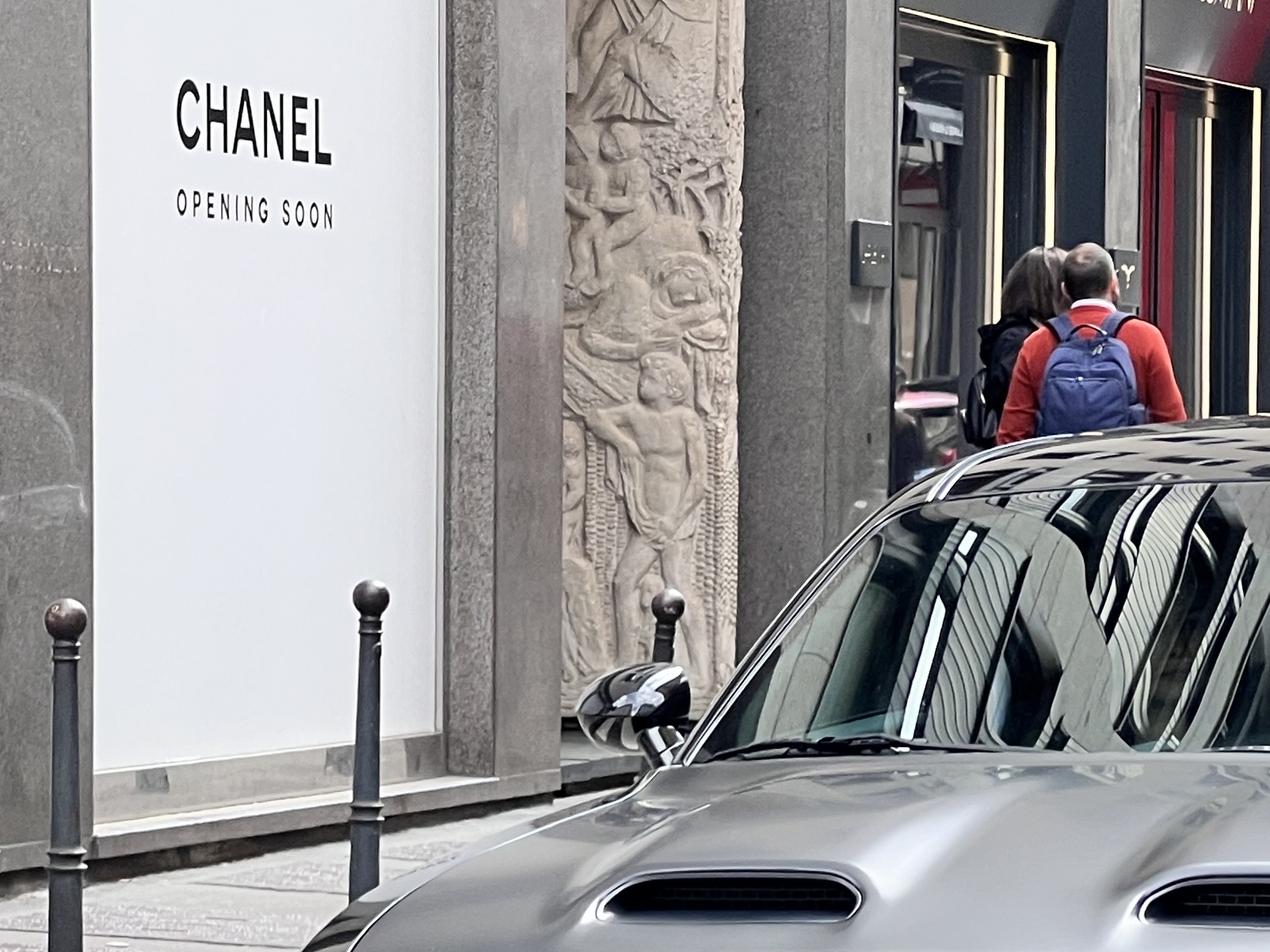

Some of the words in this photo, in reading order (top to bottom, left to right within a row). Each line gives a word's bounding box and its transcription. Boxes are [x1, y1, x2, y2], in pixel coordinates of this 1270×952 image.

[176, 79, 332, 166] CHANEL
[176, 188, 269, 224] OPENING
[282, 199, 333, 230] SOON
